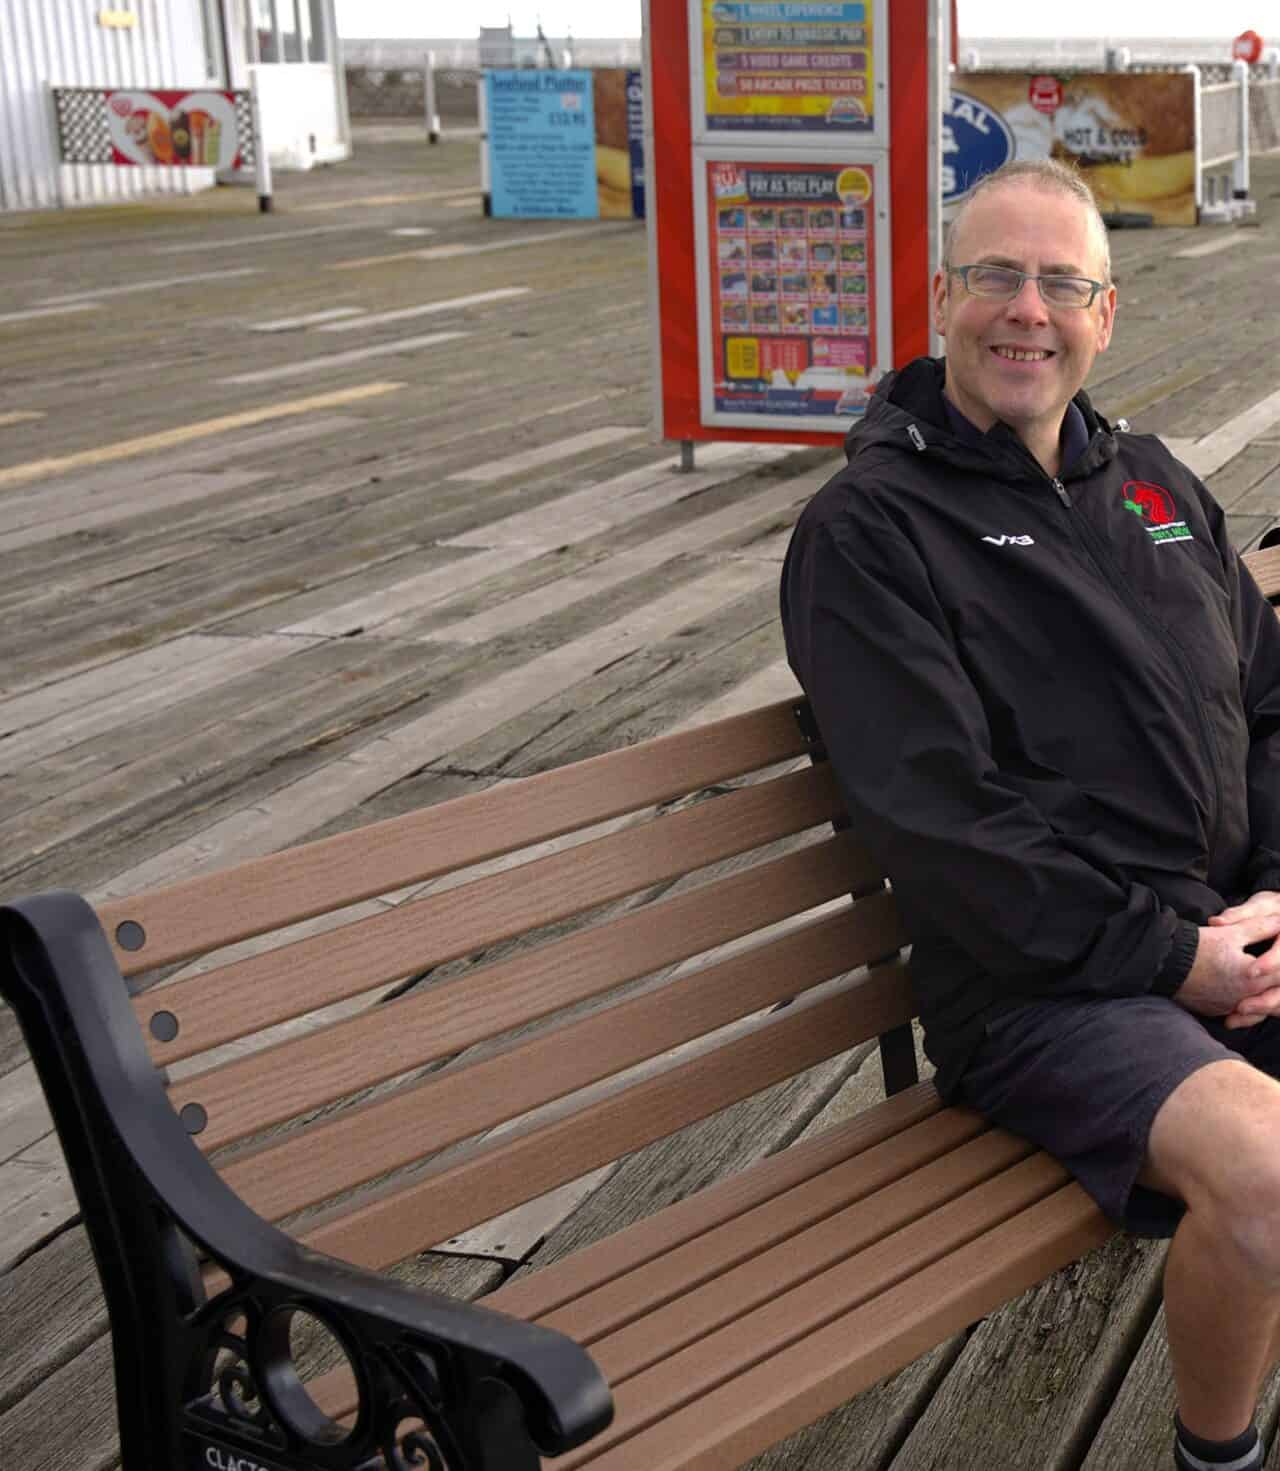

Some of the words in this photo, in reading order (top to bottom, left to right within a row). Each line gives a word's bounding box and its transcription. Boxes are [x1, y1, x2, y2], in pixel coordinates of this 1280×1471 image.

[785, 4, 843, 17] EXPERIENCE
[750, 55, 779, 67] VIDEO
[780, 55, 809, 67] GAME
[811, 55, 852, 67] CREDITS
[754, 79, 793, 91] ARCADE
[795, 79, 822, 91] PRIZE
[824, 79, 864, 91] TICKETS
[1064, 127, 1092, 145] HOT
[1111, 128, 1149, 146] COLD
[750, 178, 768, 193] PAY
[771, 178, 783, 193] AS
[787, 178, 806, 193] YOU
[809, 178, 834, 193] PLAY
